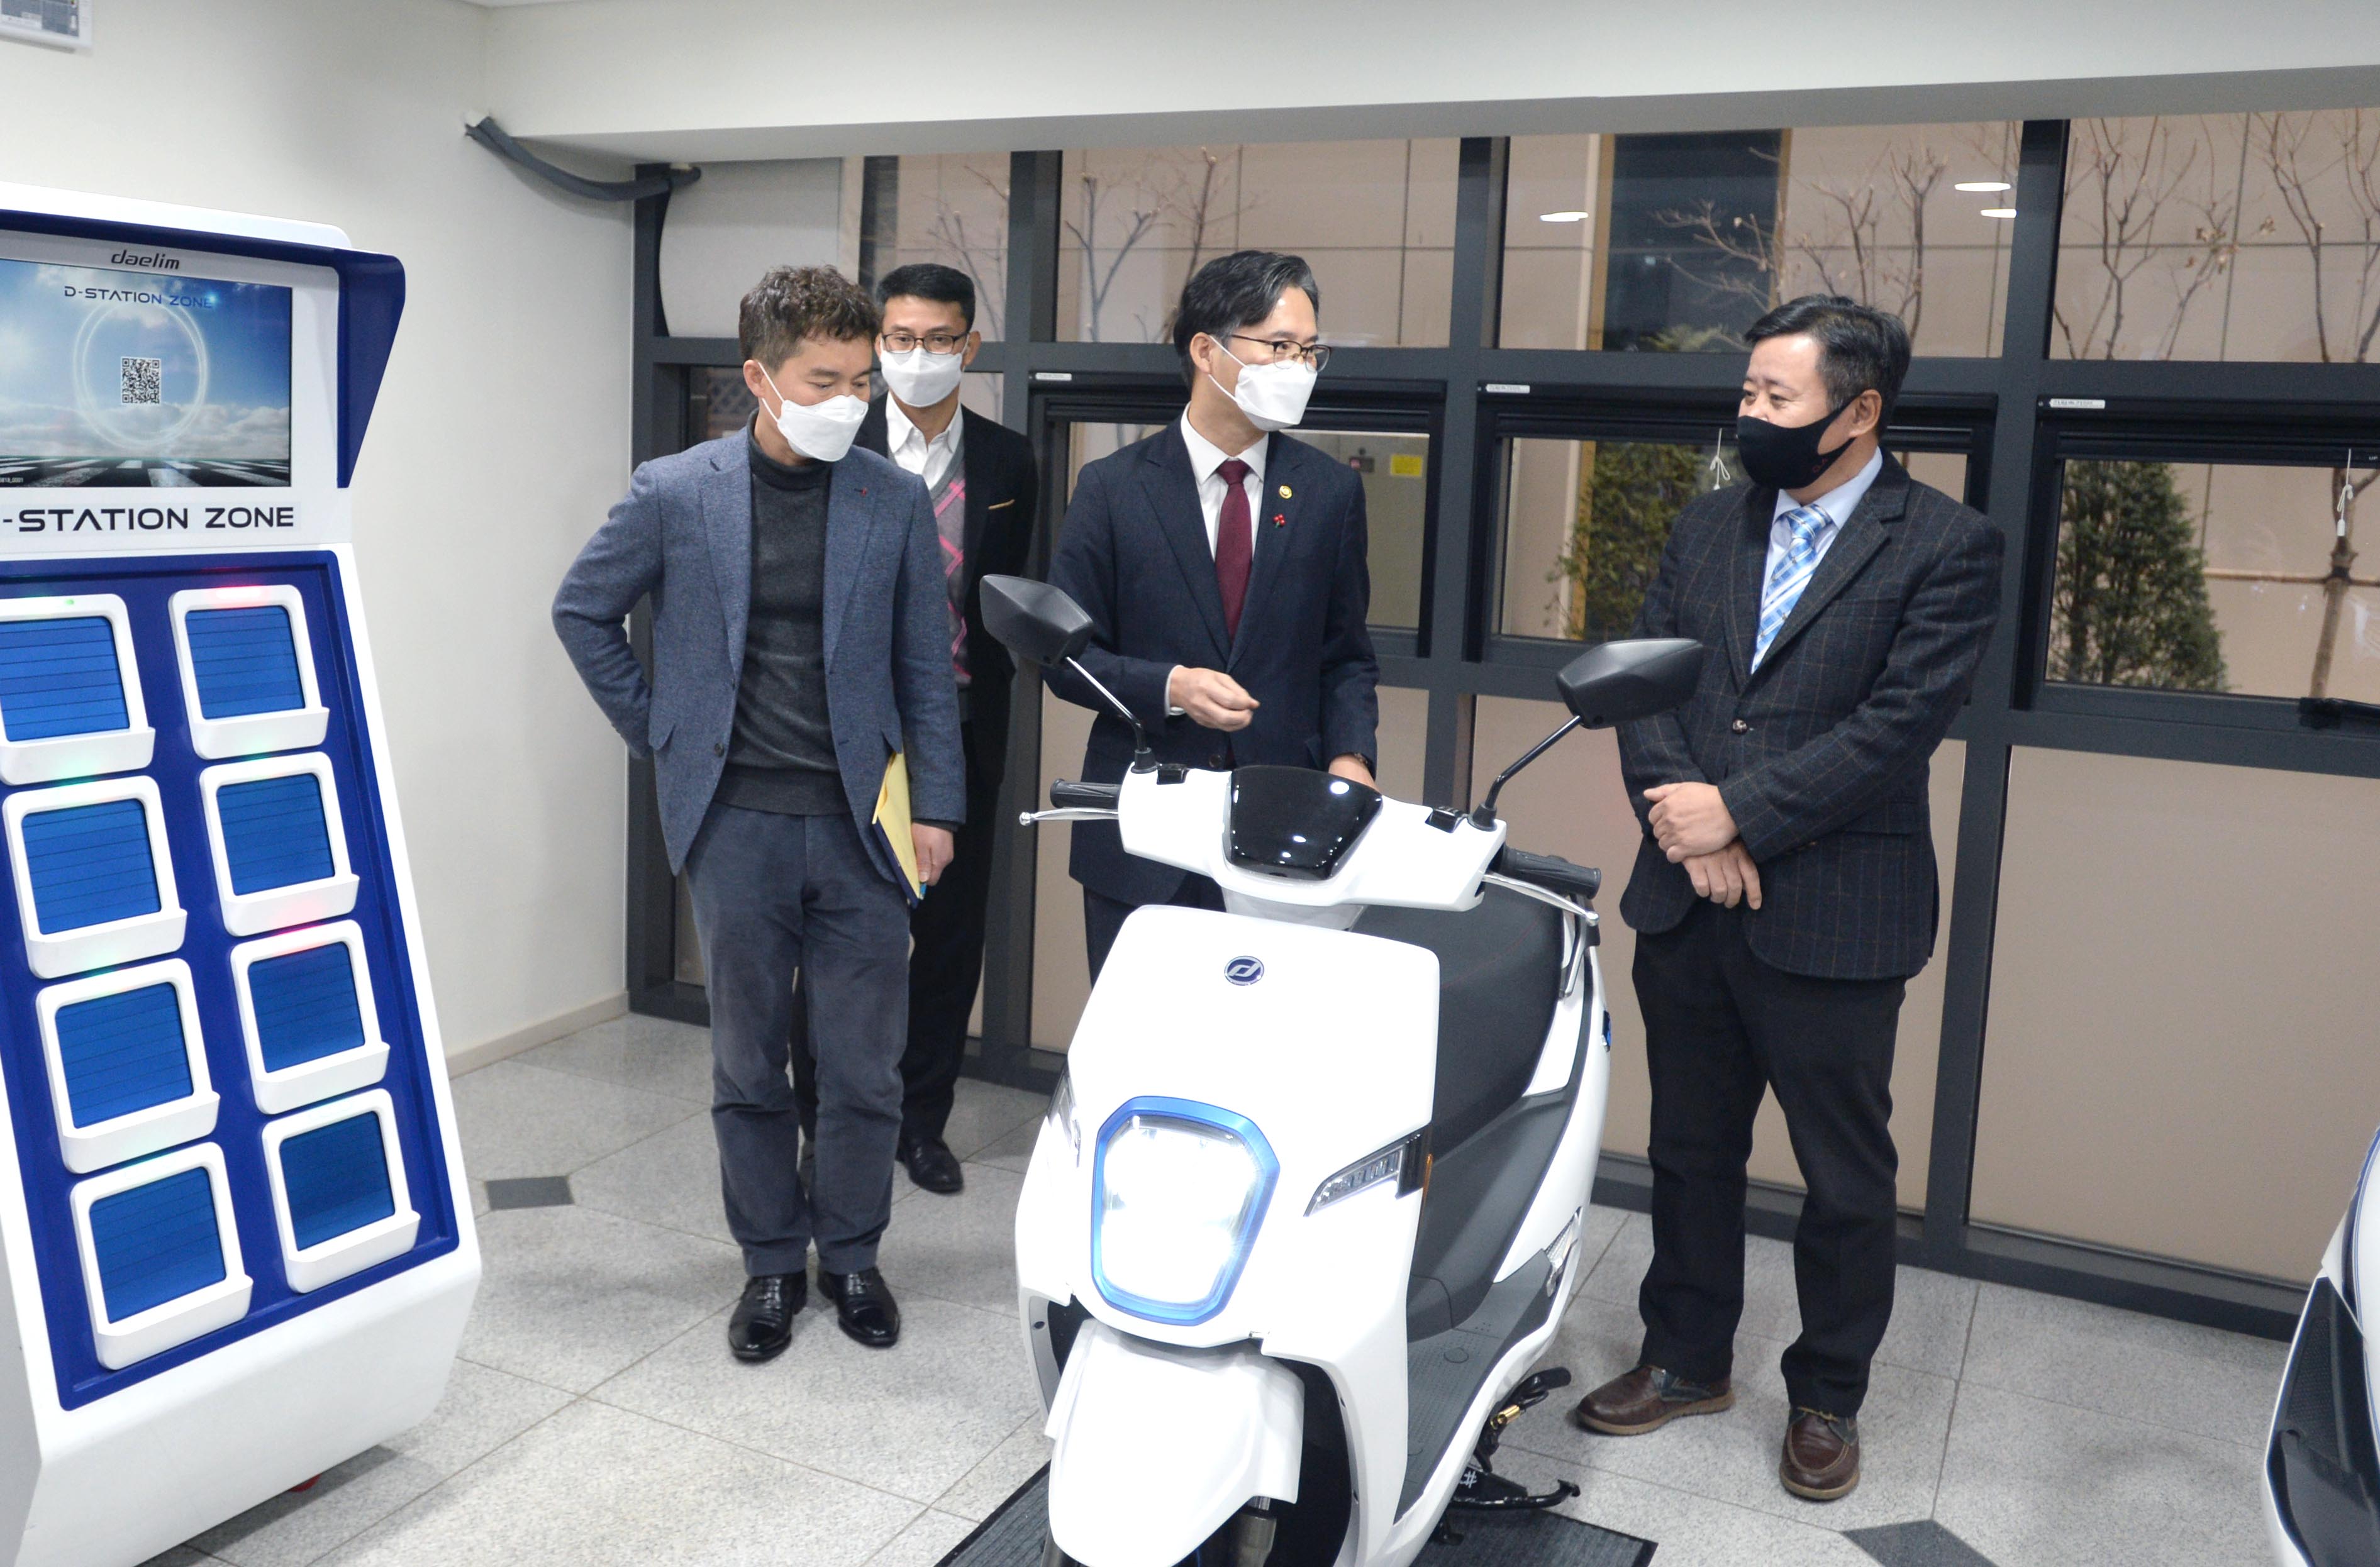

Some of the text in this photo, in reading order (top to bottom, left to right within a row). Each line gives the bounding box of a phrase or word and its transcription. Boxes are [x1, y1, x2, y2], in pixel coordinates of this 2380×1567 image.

[111, 249, 180, 270] daelim
[64, 285, 213, 309] D-STATION ZONE
[204, 507, 294, 528] ZONE
